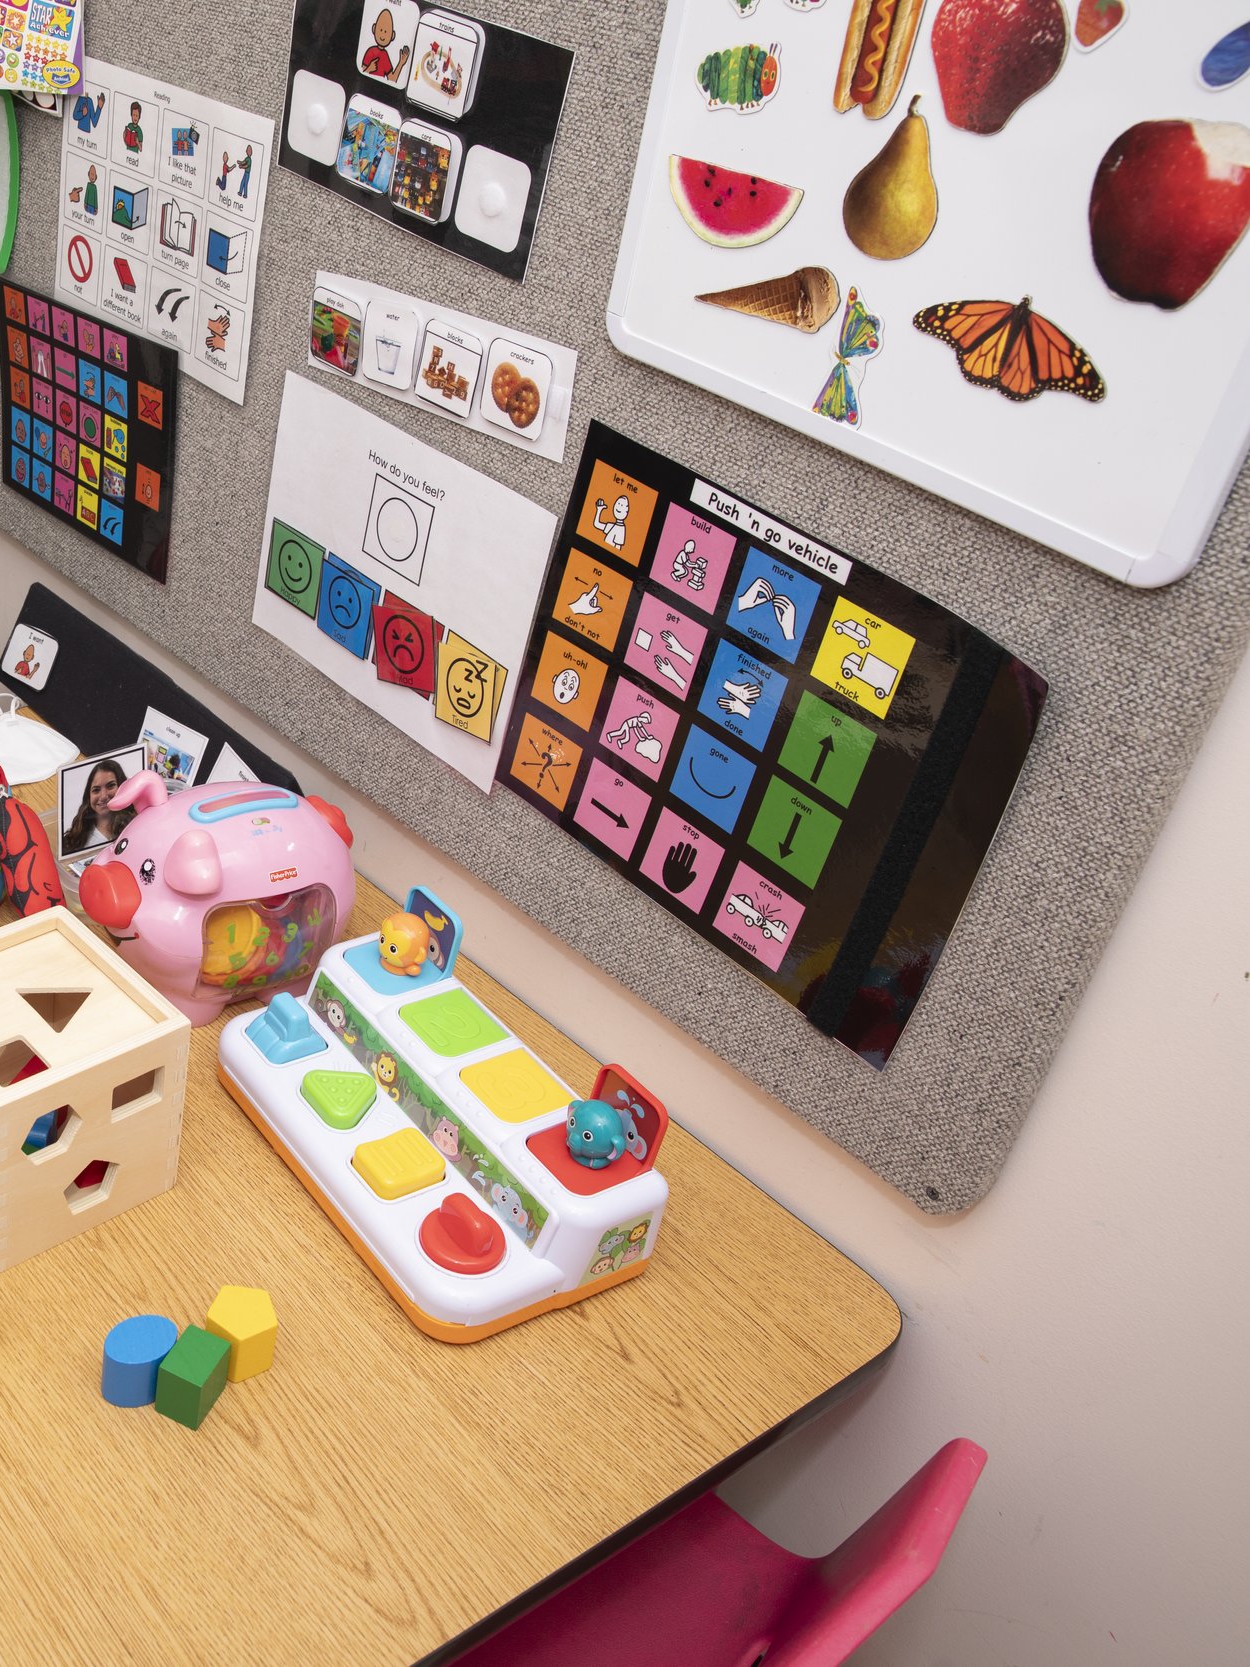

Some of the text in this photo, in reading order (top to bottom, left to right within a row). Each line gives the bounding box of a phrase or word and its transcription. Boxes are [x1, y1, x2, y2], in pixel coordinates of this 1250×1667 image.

[31, 3, 53, 26] STAR
[30, 22, 70, 38] Achiever
[153, 90, 171, 104] Reading
[369, 107, 384, 120] books
[77, 136, 98, 151] my turn
[125, 155, 139, 167] read
[168, 156, 197, 176] I like that
[171, 174, 193, 189] picture
[219, 191, 244, 212] help me
[71, 209, 95, 226] your turn
[120, 231, 135, 244] open
[161, 249, 190, 270] turn page
[73, 284, 83, 295] not
[215, 276, 231, 291] close
[110, 288, 134, 307] I want a
[103, 298, 142, 324] different book
[386, 313, 401, 321] water
[161, 328, 178, 342] again
[447, 332, 464, 345] blocks
[204, 350, 228, 371] finished
[510, 350, 535, 366] crackers
[368, 449, 446, 501] How do you feel?
[613, 473, 639, 494] let me
[690, 516, 712, 535] build
[708, 491, 838, 575] Push 'n go vehicle
[592, 566, 603, 577] no
[772, 563, 795, 582] more
[280, 586, 301, 606] Happy
[666, 612, 681, 625] get
[864, 617, 882, 630] car
[28, 631, 33, 640] I
[333, 629, 347, 643] Sad
[564, 616, 601, 641] don't not
[747, 626, 770, 645] again
[563, 651, 589, 670] uh-oh!
[737, 653, 772, 680] finished
[834, 680, 860, 701] truck
[636, 693, 655, 710] push
[452, 714, 469, 730] Tired
[724, 719, 744, 737] done
[830, 714, 843, 727] up
[541, 727, 563, 746] where
[709, 746, 730, 764] gone
[614, 778, 624, 788] go
[790, 796, 813, 816] down
[682, 823, 700, 841] stop
[759, 880, 783, 901] crash
[225, 908, 322, 947] 1 2 3 4
[731, 931, 758, 955] smash
[229, 940, 314, 971] 5 6 7
